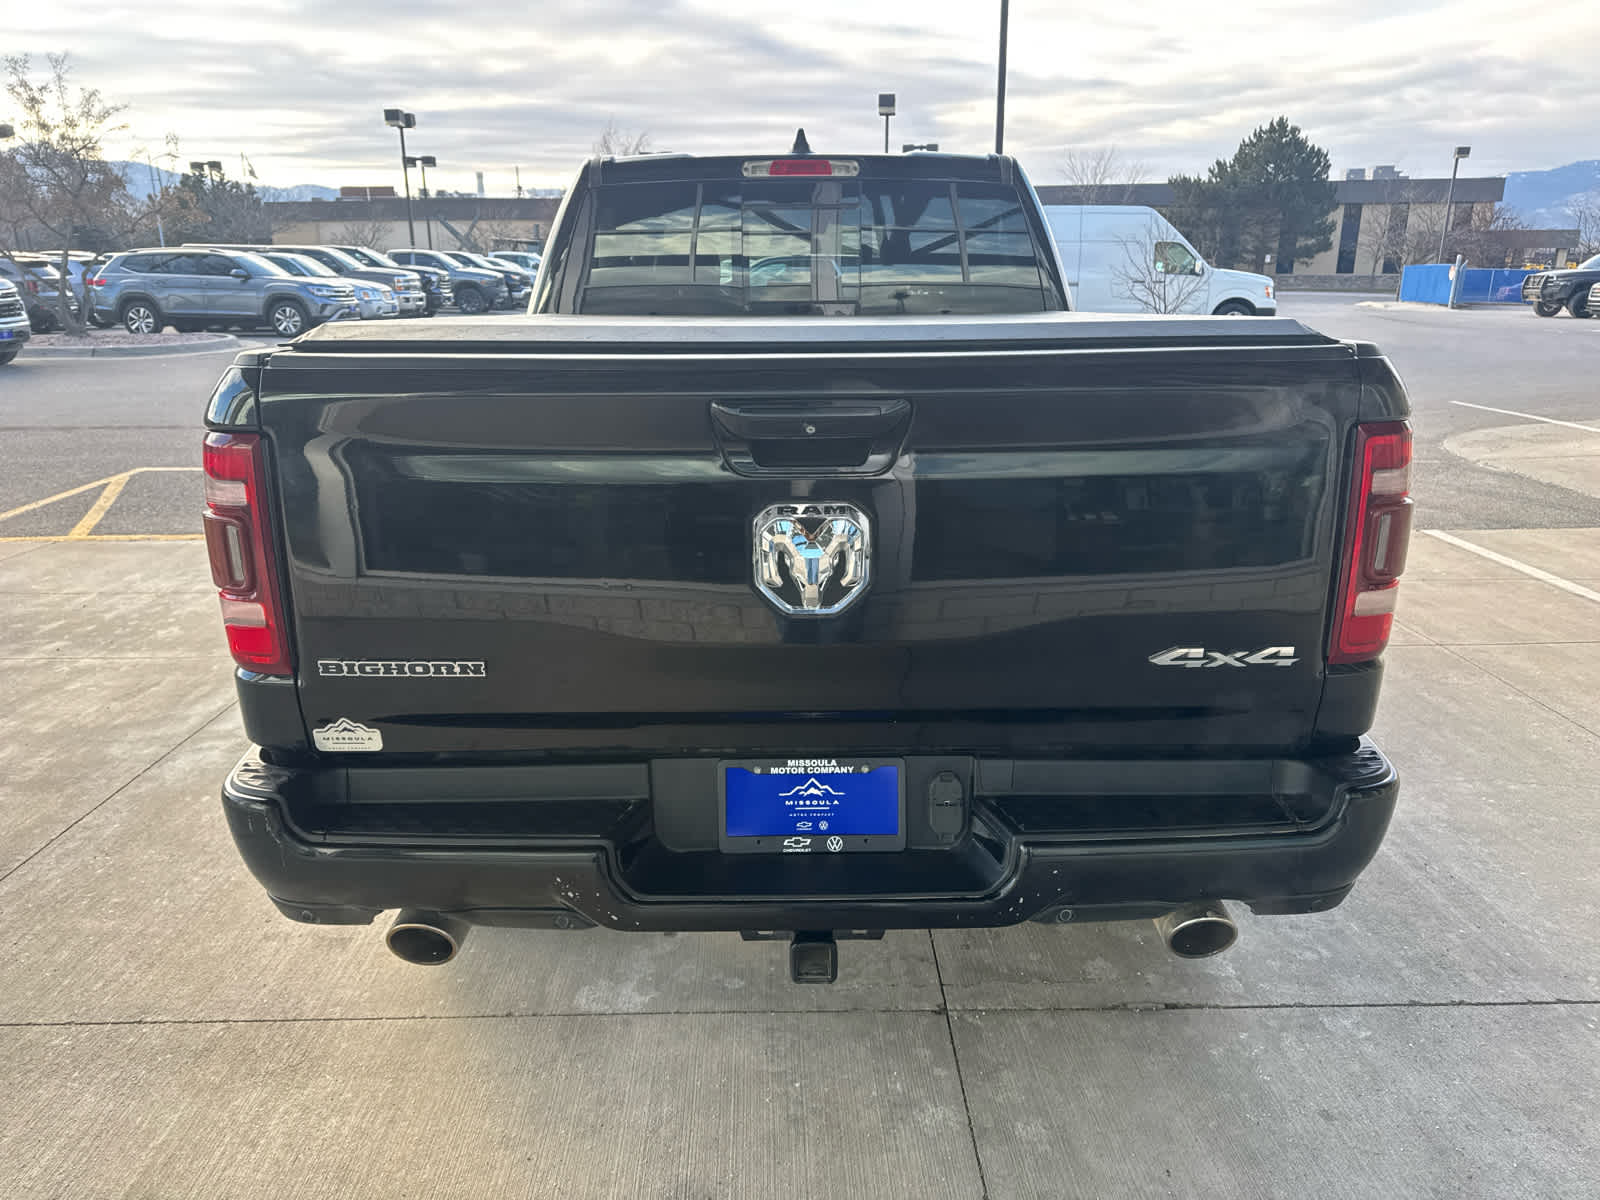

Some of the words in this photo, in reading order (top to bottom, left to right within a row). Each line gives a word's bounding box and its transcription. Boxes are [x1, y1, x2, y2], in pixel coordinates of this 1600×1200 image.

[777, 506, 846, 515] RAM
[317, 660, 486, 677] BIGHORN
[787, 759, 837, 767] MISSOULA
[807, 766, 854, 774] COMPANY
